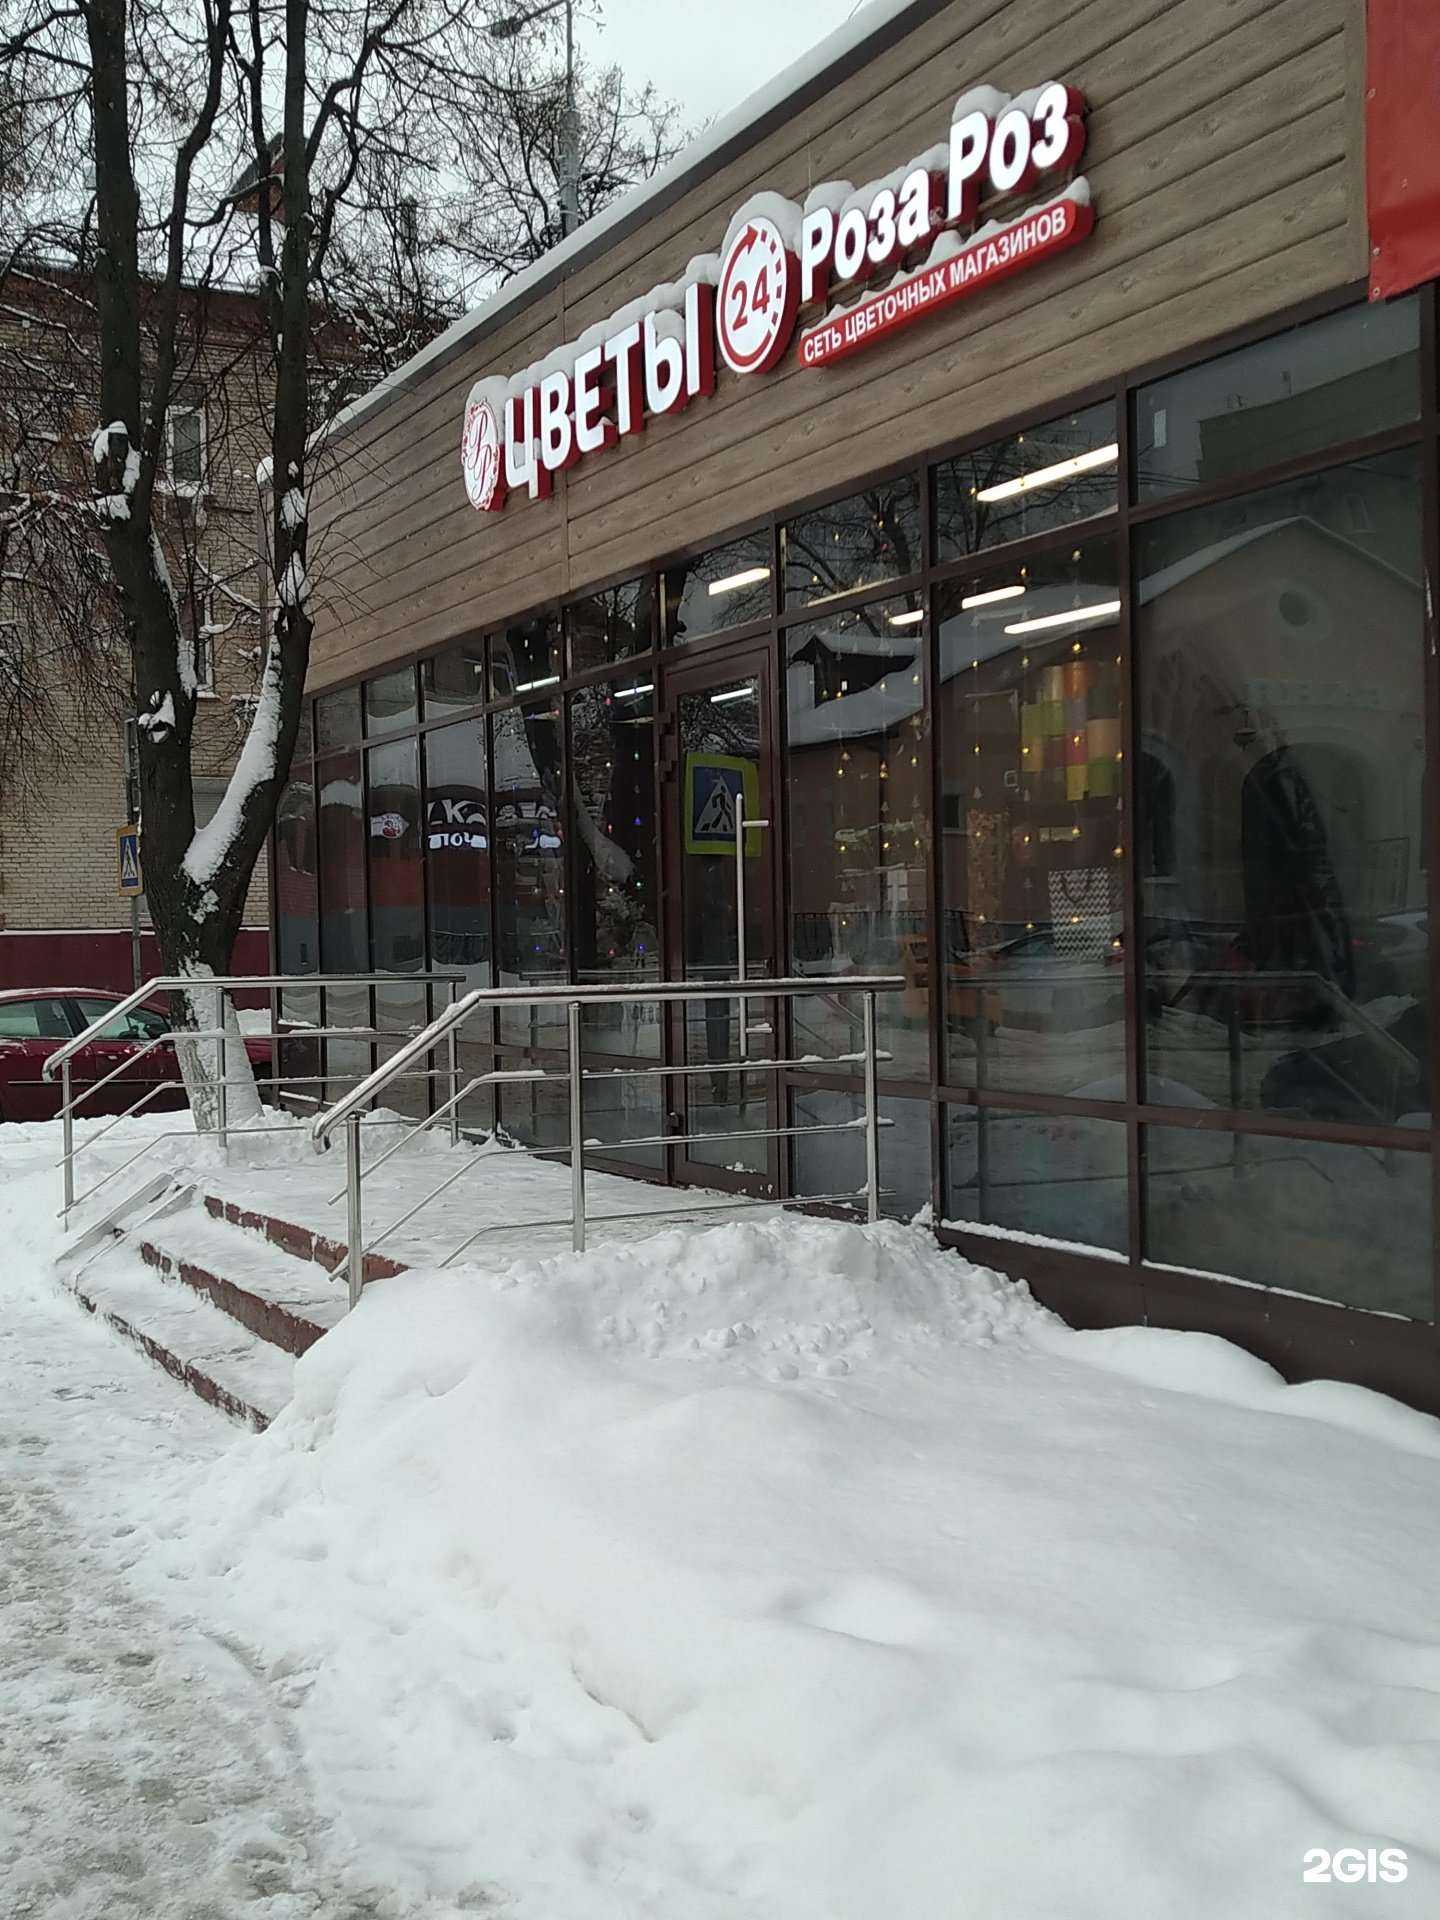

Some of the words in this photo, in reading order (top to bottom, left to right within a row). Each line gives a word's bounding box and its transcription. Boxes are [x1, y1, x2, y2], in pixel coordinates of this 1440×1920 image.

[731, 265, 770, 331] 24
[804, 333, 842, 362] СЕТЬ
[845, 267, 947, 341] ЦВЕТОЧНЫХ
[950, 206, 1066, 287] МАГАЗИНОВ
[505, 282, 700, 499] ЦВЕТЫ
